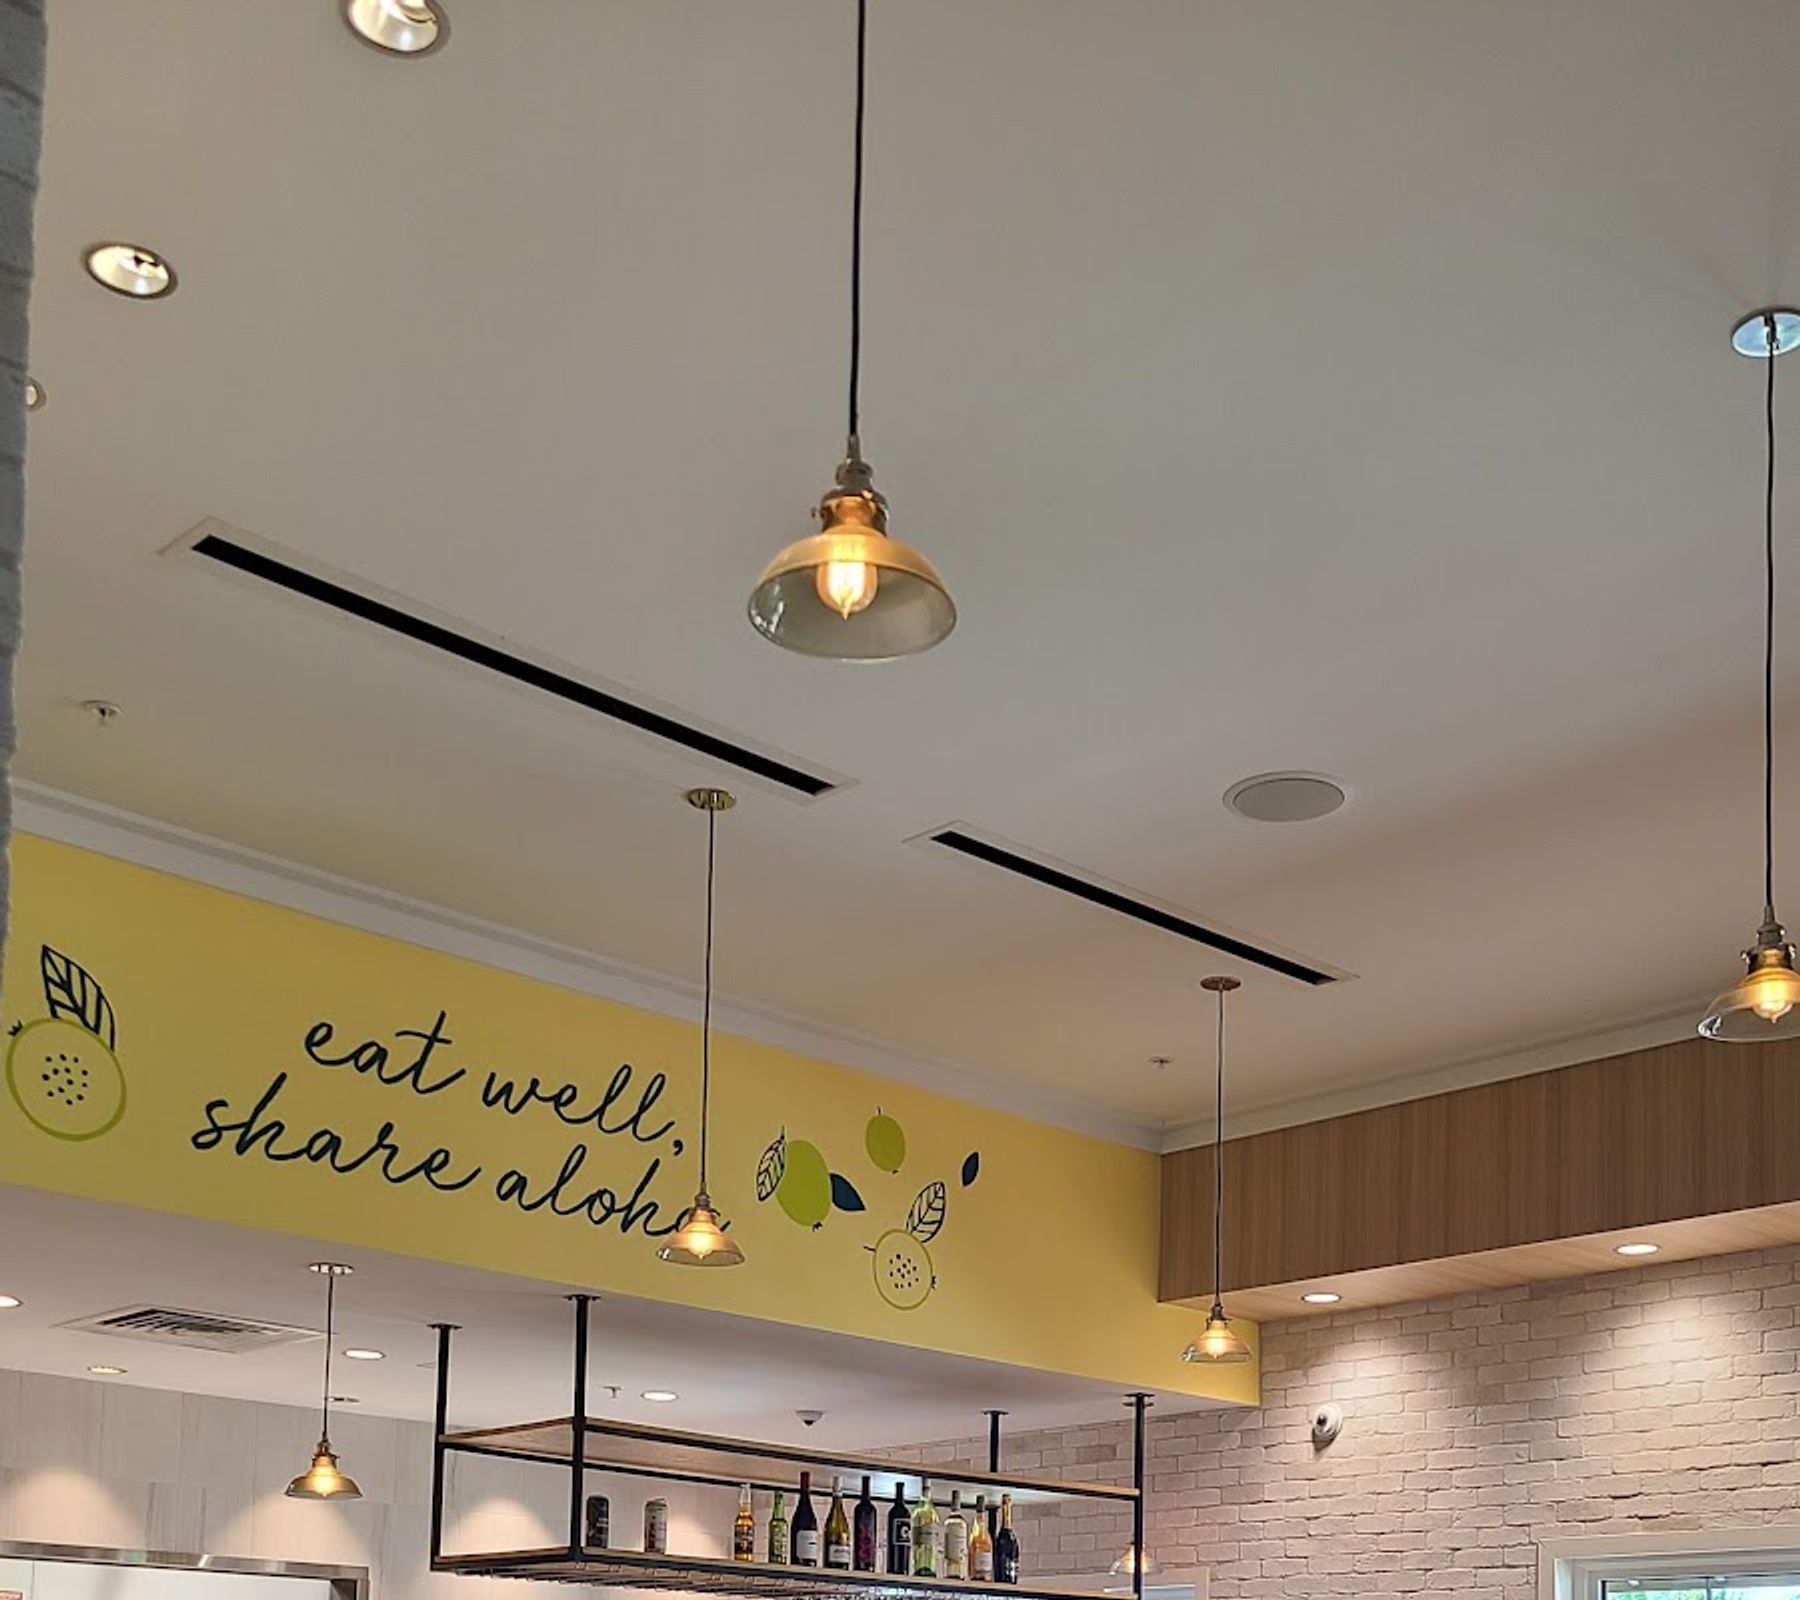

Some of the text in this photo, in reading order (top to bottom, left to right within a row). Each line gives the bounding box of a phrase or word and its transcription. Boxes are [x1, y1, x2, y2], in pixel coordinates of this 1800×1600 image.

[192, 1072, 482, 1191] share
[305, 1010, 685, 1156] eat well,
